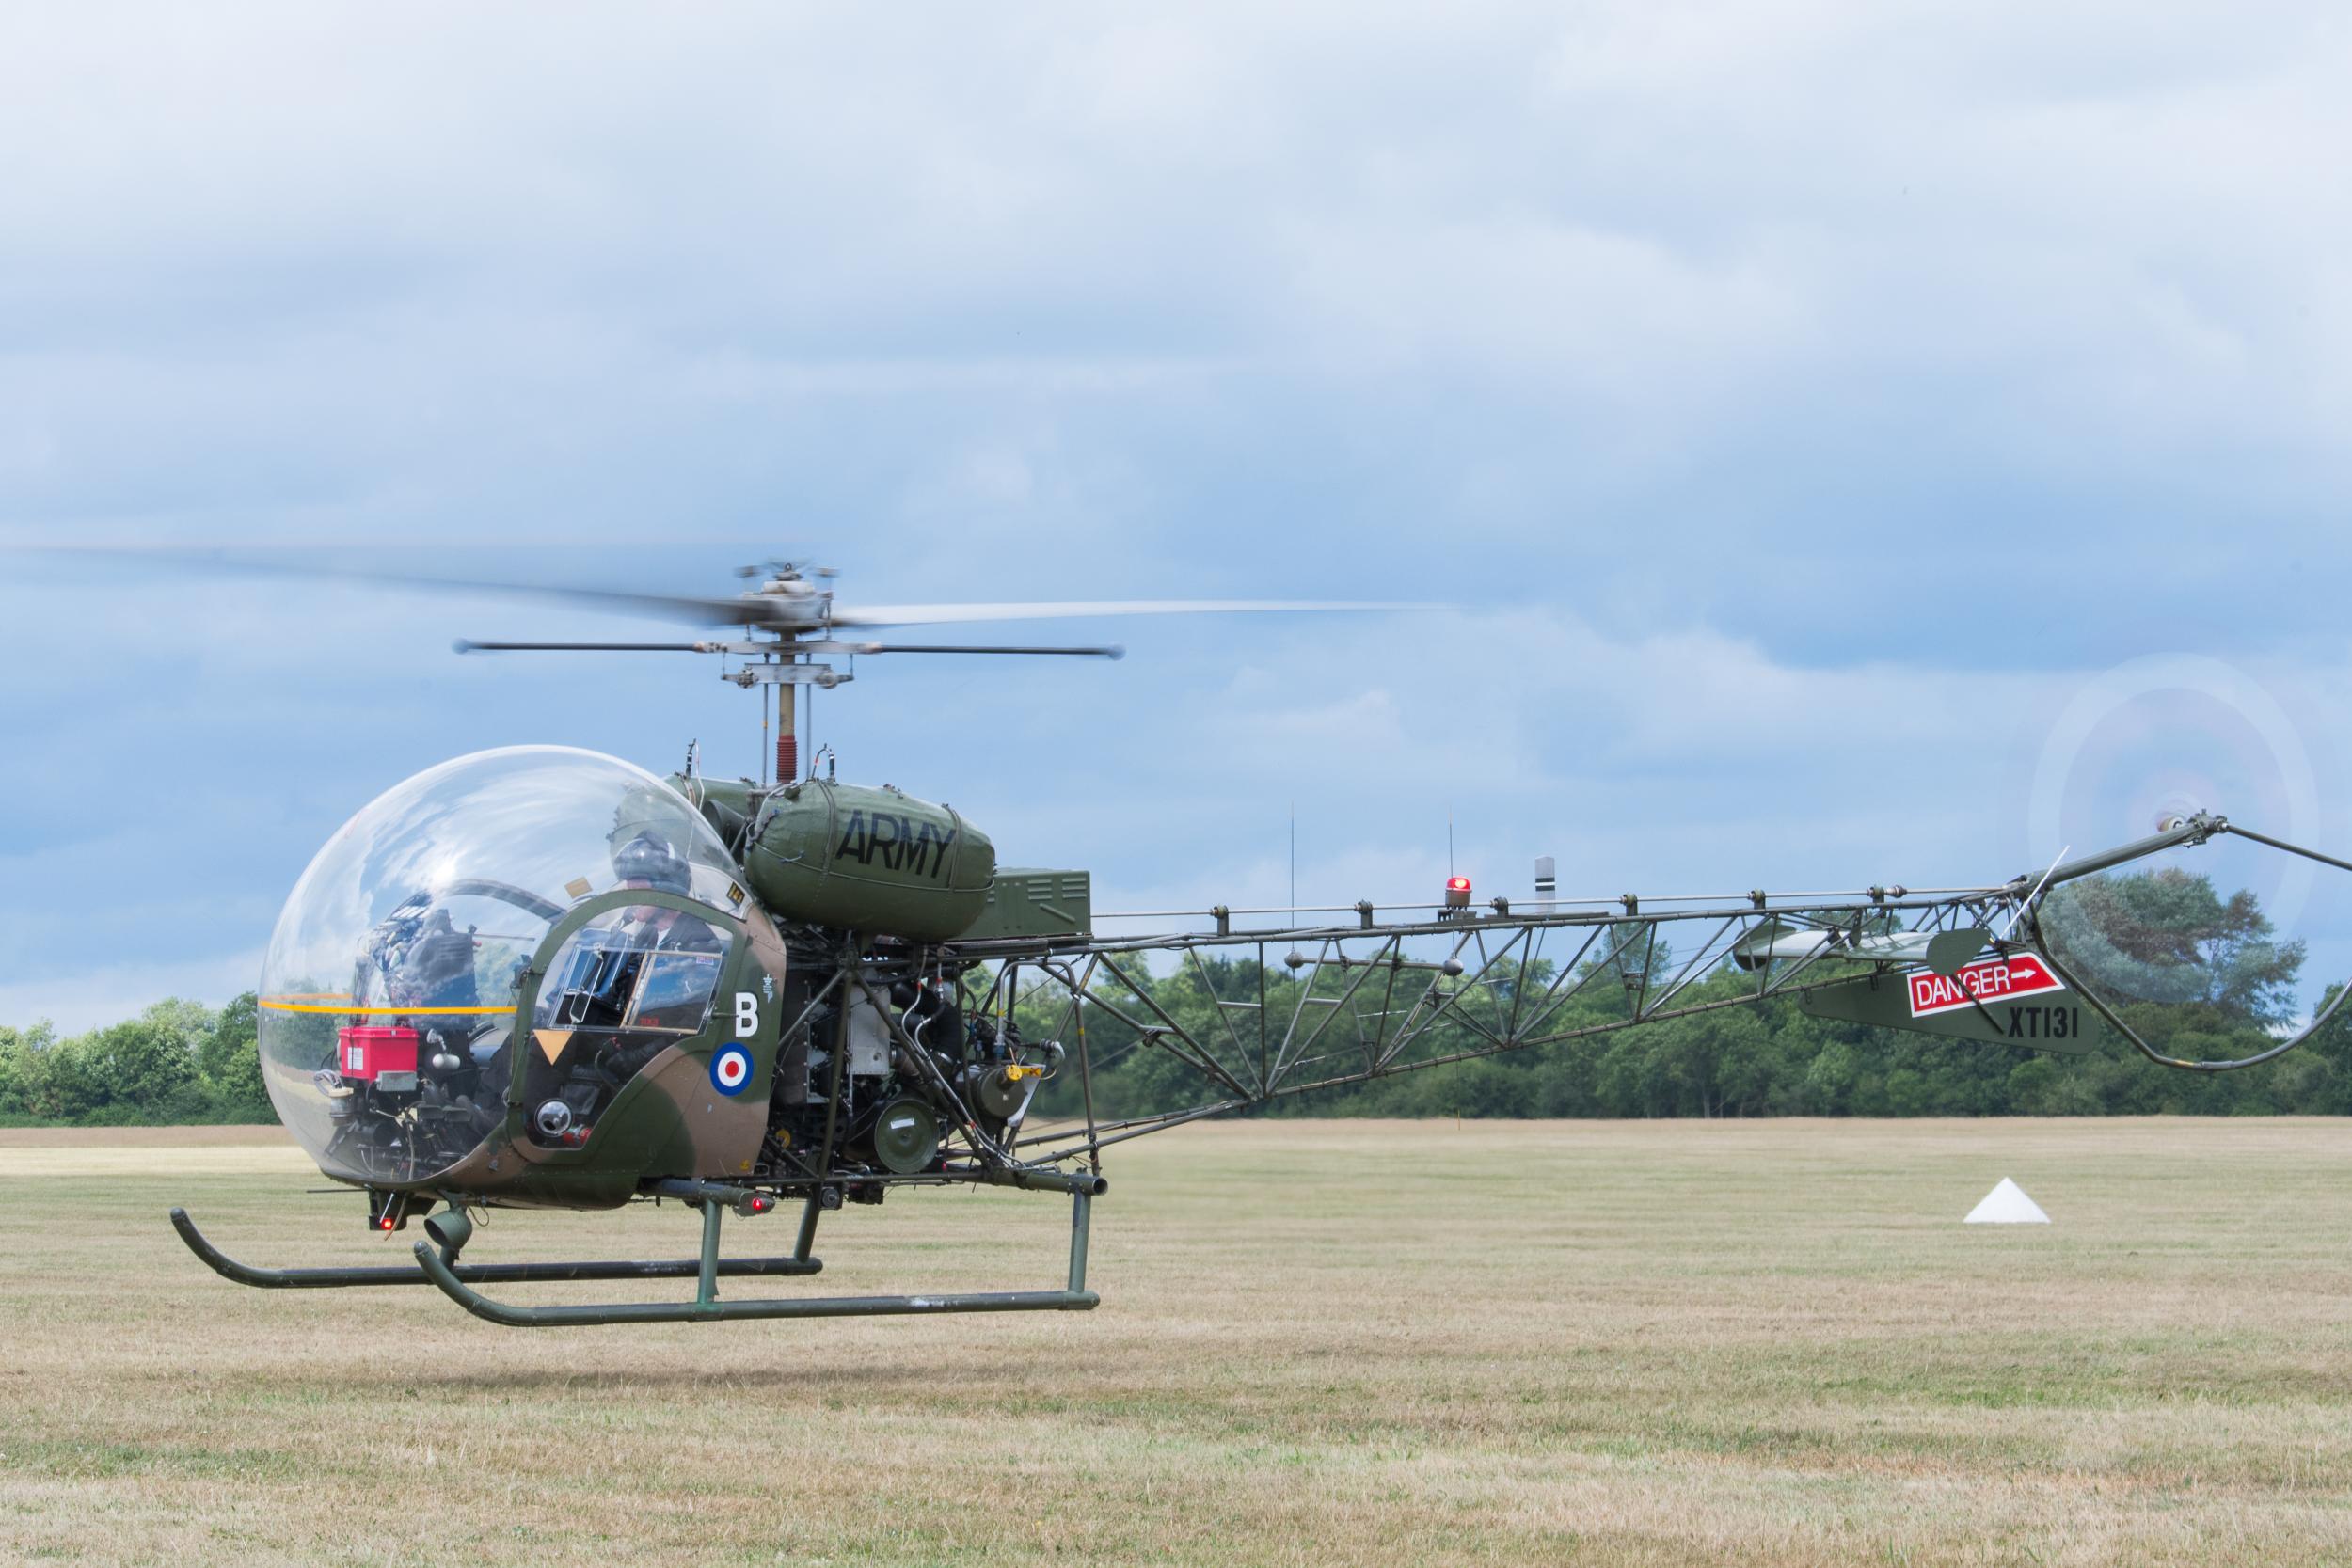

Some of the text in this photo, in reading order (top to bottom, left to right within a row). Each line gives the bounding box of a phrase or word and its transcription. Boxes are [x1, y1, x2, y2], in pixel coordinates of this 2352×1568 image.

[835, 809, 957, 879] ARMY
[1915, 965, 2011, 1006] DANGER
[735, 991, 759, 1037] B
[2008, 1006, 2078, 1038] XT131
